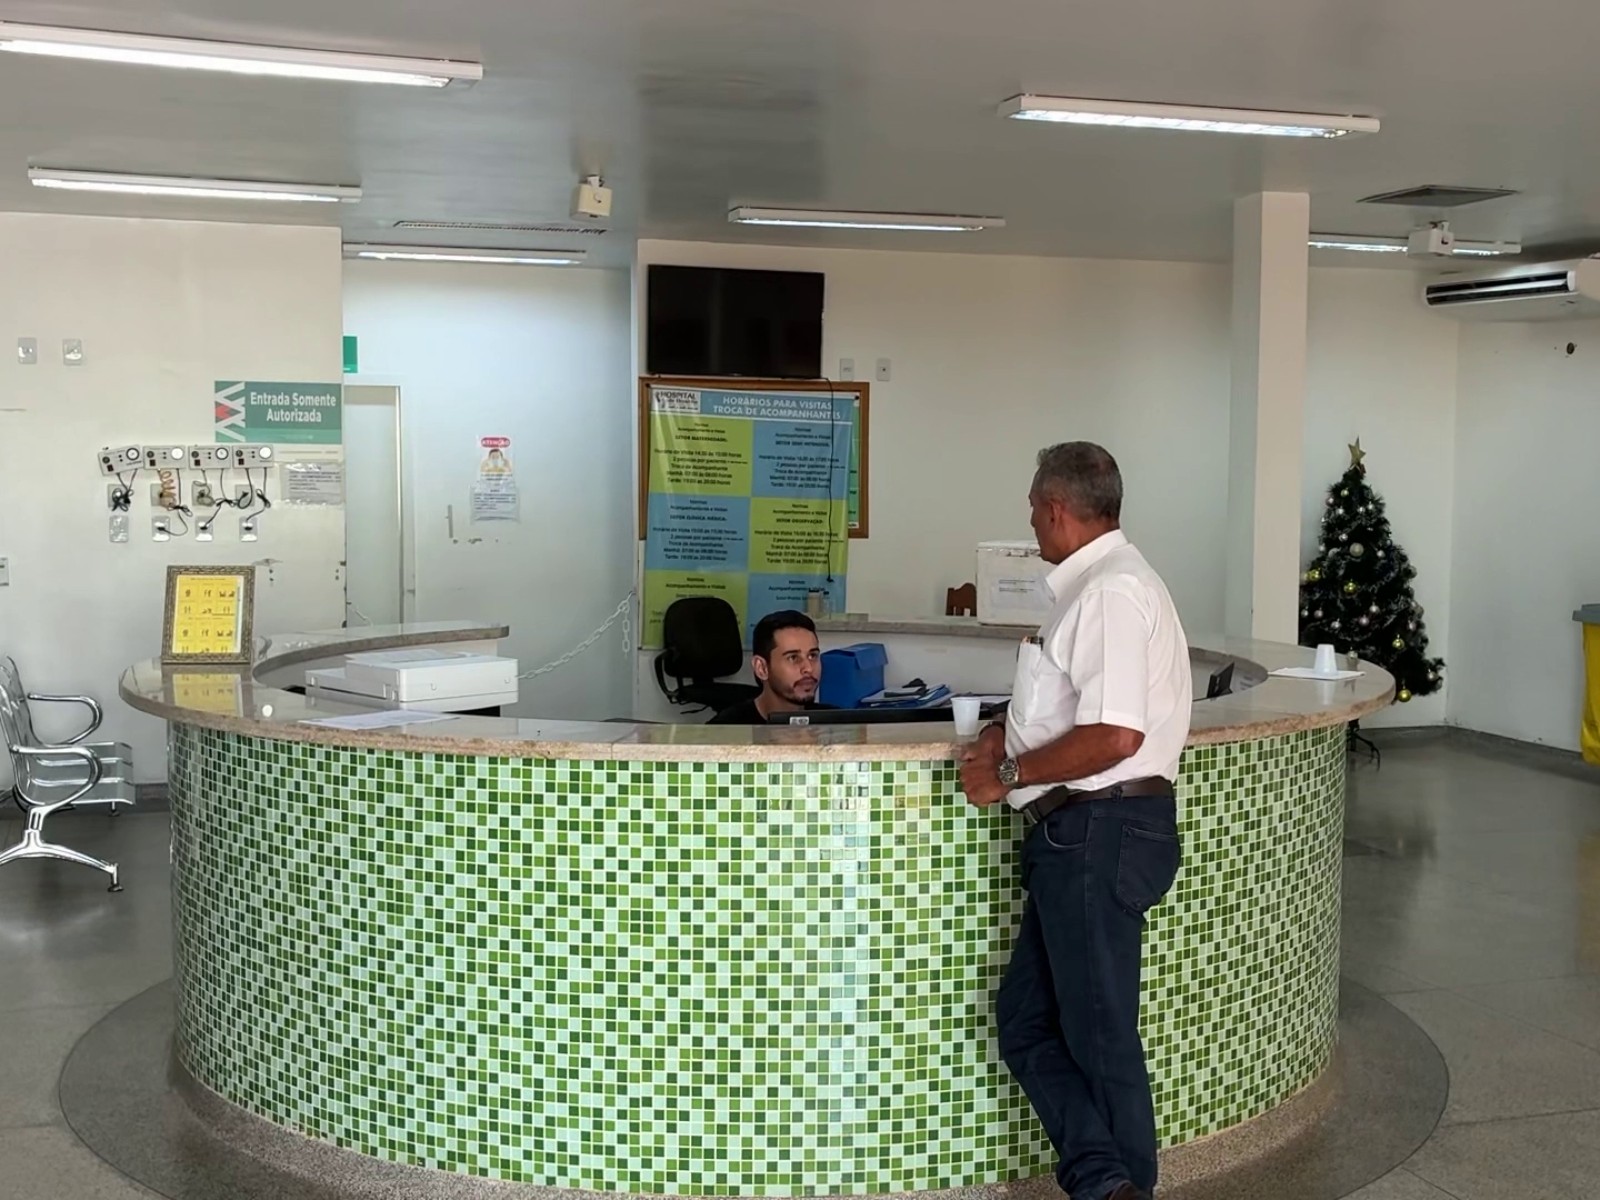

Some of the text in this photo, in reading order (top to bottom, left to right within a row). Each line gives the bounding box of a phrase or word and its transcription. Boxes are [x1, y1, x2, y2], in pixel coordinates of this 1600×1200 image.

[250, 392, 336, 406] Entrada Somente
[660, 391, 696, 399] HOSPITAL
[773, 399, 797, 408] PARA
[799, 400, 832, 410] VISITAS
[266, 408, 322, 422] Autorizada
[713, 405, 743, 414] TROCA
[746, 407, 757, 416] DE
